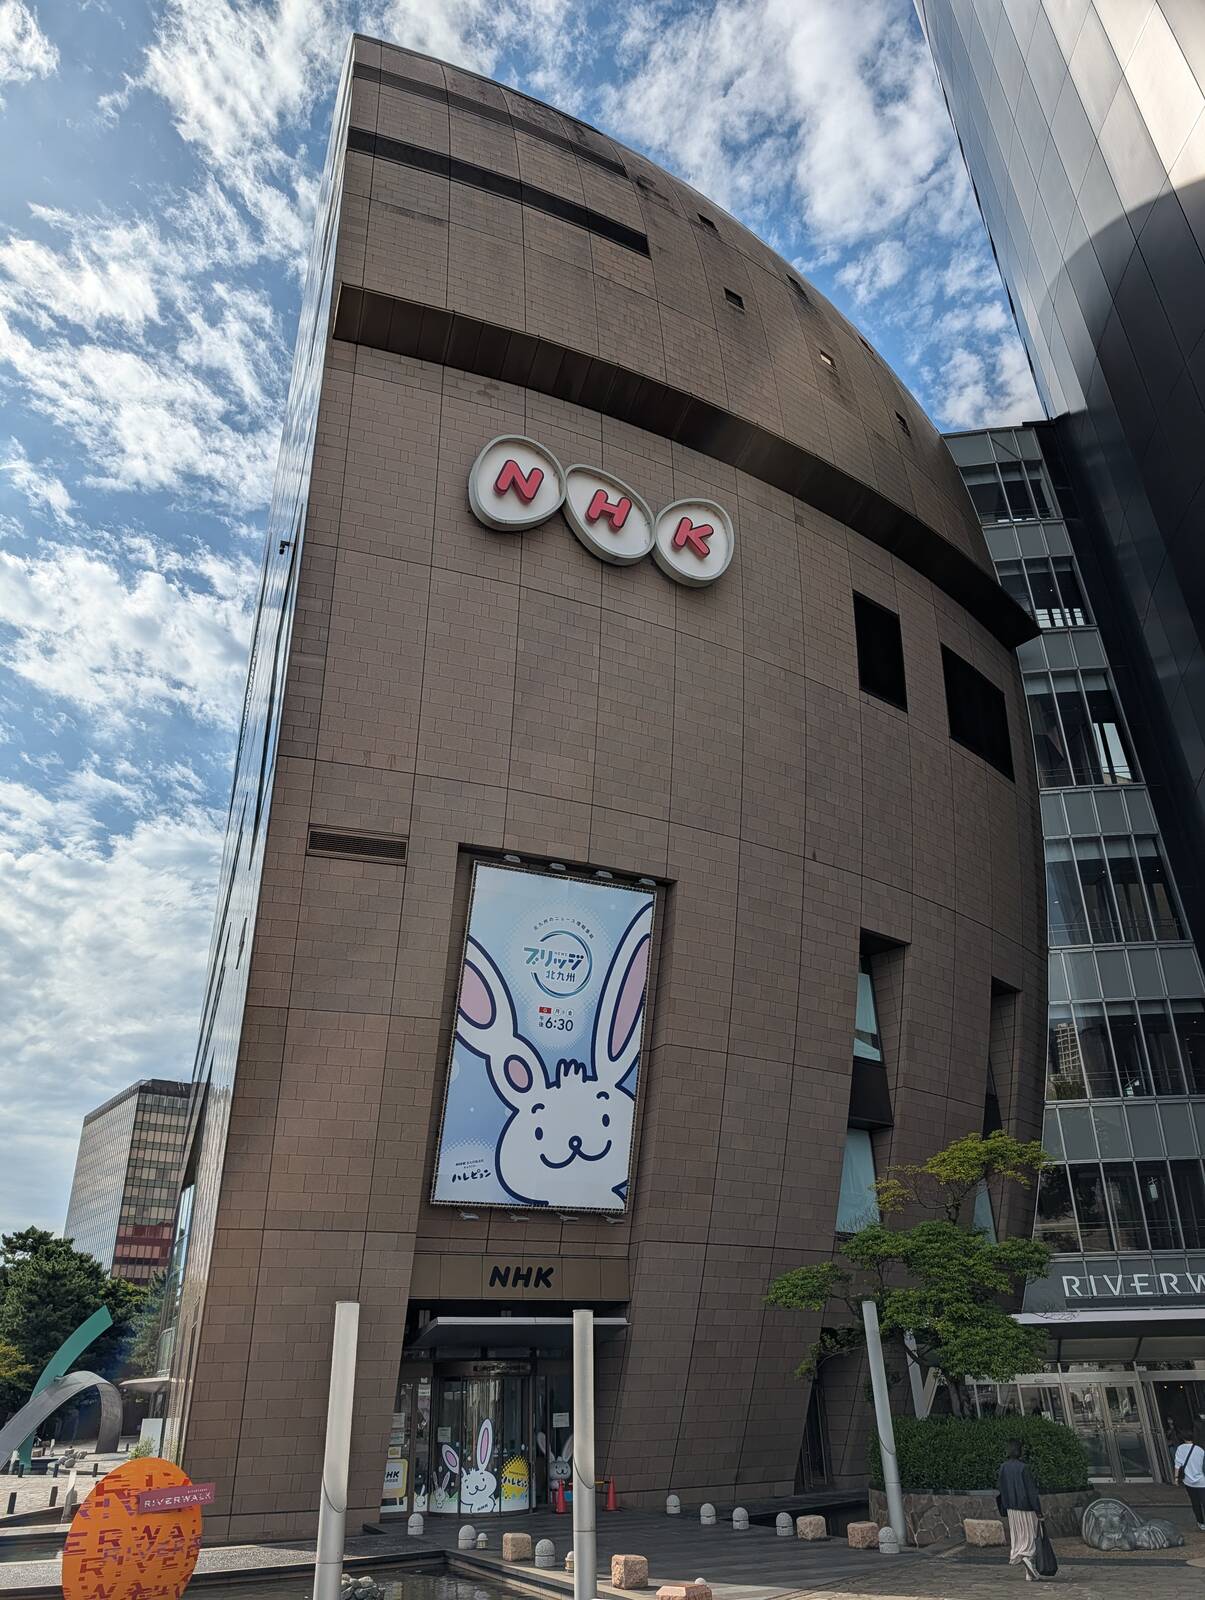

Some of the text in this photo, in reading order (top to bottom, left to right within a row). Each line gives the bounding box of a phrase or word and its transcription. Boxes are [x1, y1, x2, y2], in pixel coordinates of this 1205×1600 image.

[493, 459, 714, 558] NHK
[524, 947, 584, 971] ブリッジ
[546, 970, 576, 982] 北九州
[545, 1017, 574, 1032] 6:30
[489, 1265, 554, 1288] NHK
[384, 1471, 400, 1479] HK
[144, 1491, 212, 1508] RIVERWALK
